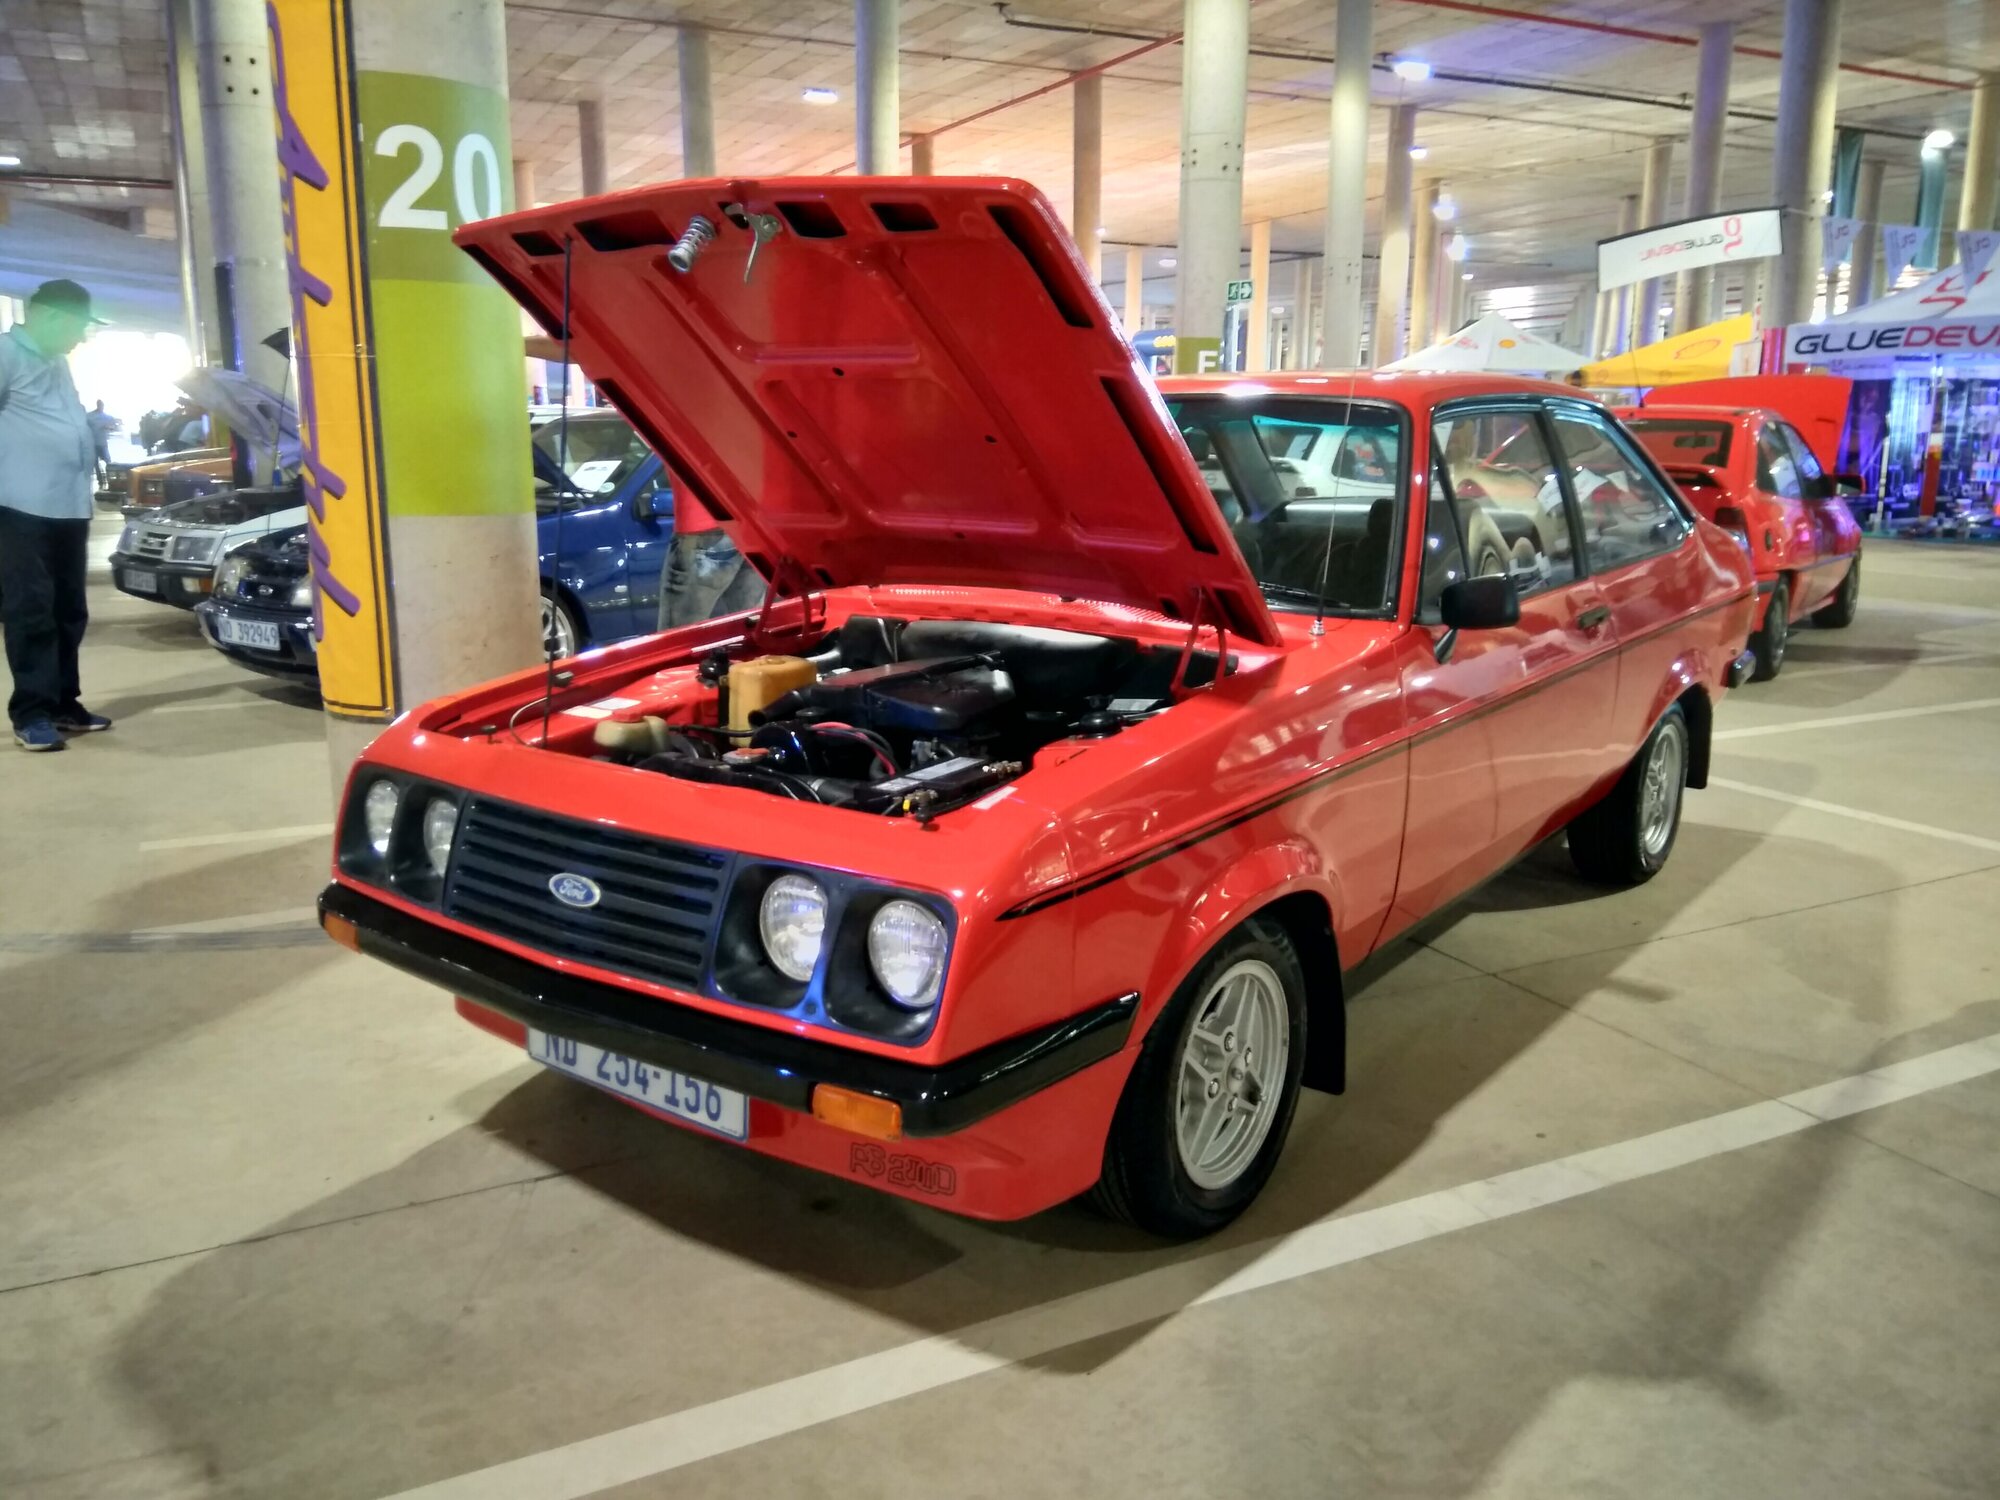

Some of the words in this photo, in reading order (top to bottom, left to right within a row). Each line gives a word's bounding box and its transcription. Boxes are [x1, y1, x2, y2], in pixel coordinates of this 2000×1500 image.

[358, 123, 502, 231] 20
[1794, 325, 2000, 355] GLUEDEV
[1197, 350, 1225, 374] F
[238, 622, 278, 646] 392949
[559, 878, 588, 901] Ford
[545, 1033, 577, 1067] ND
[887, 1153, 957, 1196] 2000
